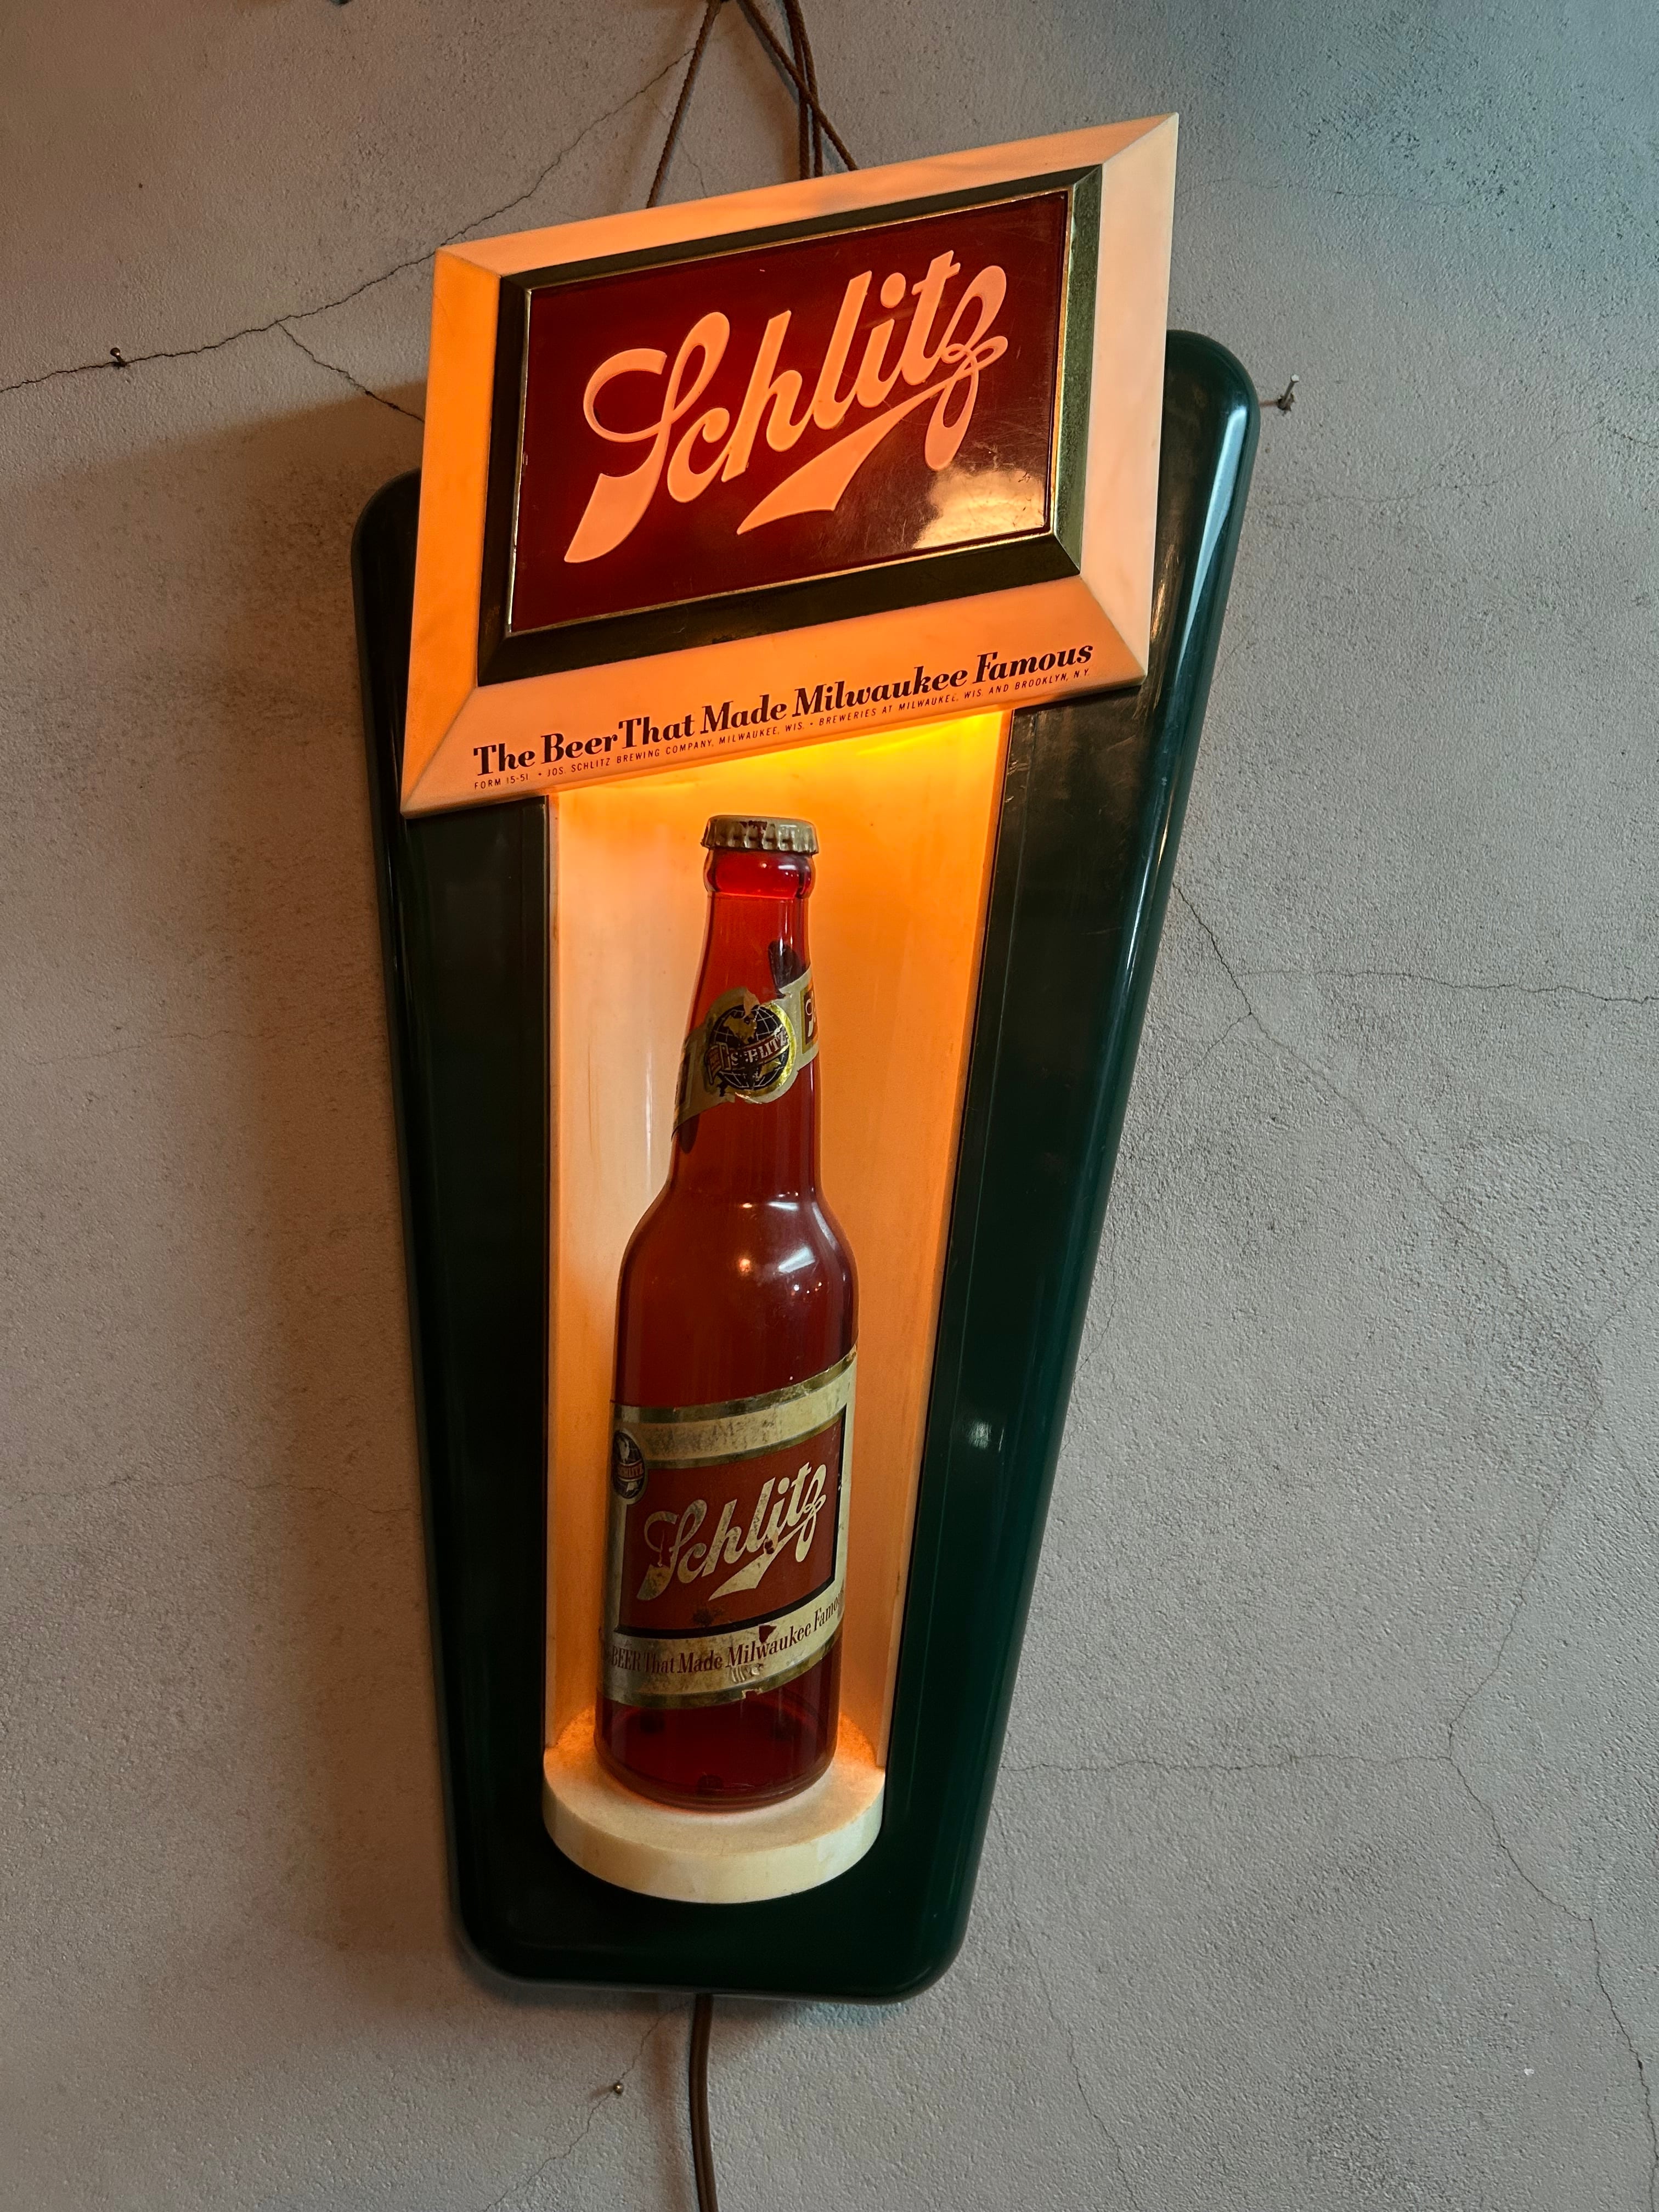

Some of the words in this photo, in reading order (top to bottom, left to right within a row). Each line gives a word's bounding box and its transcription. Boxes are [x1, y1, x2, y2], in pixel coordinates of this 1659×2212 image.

[563, 250, 1008, 563] Schlitz
[473, 742, 535, 776] The
[540, 732, 618, 764] Beer
[618, 716, 695, 749] That
[700, 694, 787, 734] Made
[792, 665, 968, 717] Milwaukee
[972, 645, 1093, 685] Famous
[474, 778, 501, 789] FORM
[506, 774, 529, 785] 15-51
[571, 758, 611, 773] SCHLITZ
[617, 748, 660, 764] BREWING
[819, 708, 877, 726] BREWERIES
[882, 704, 893, 714] AT
[989, 684, 1009, 695] AND
[1014, 672, 1069, 690] BROOKLYN,
[636, 1462, 827, 1601] Schlitz
[611, 1646, 641, 1672] BEER
[644, 1651, 674, 1674] That
[677, 1652, 723, 1674] Made
[725, 1622, 811, 1668] Milwaukee
